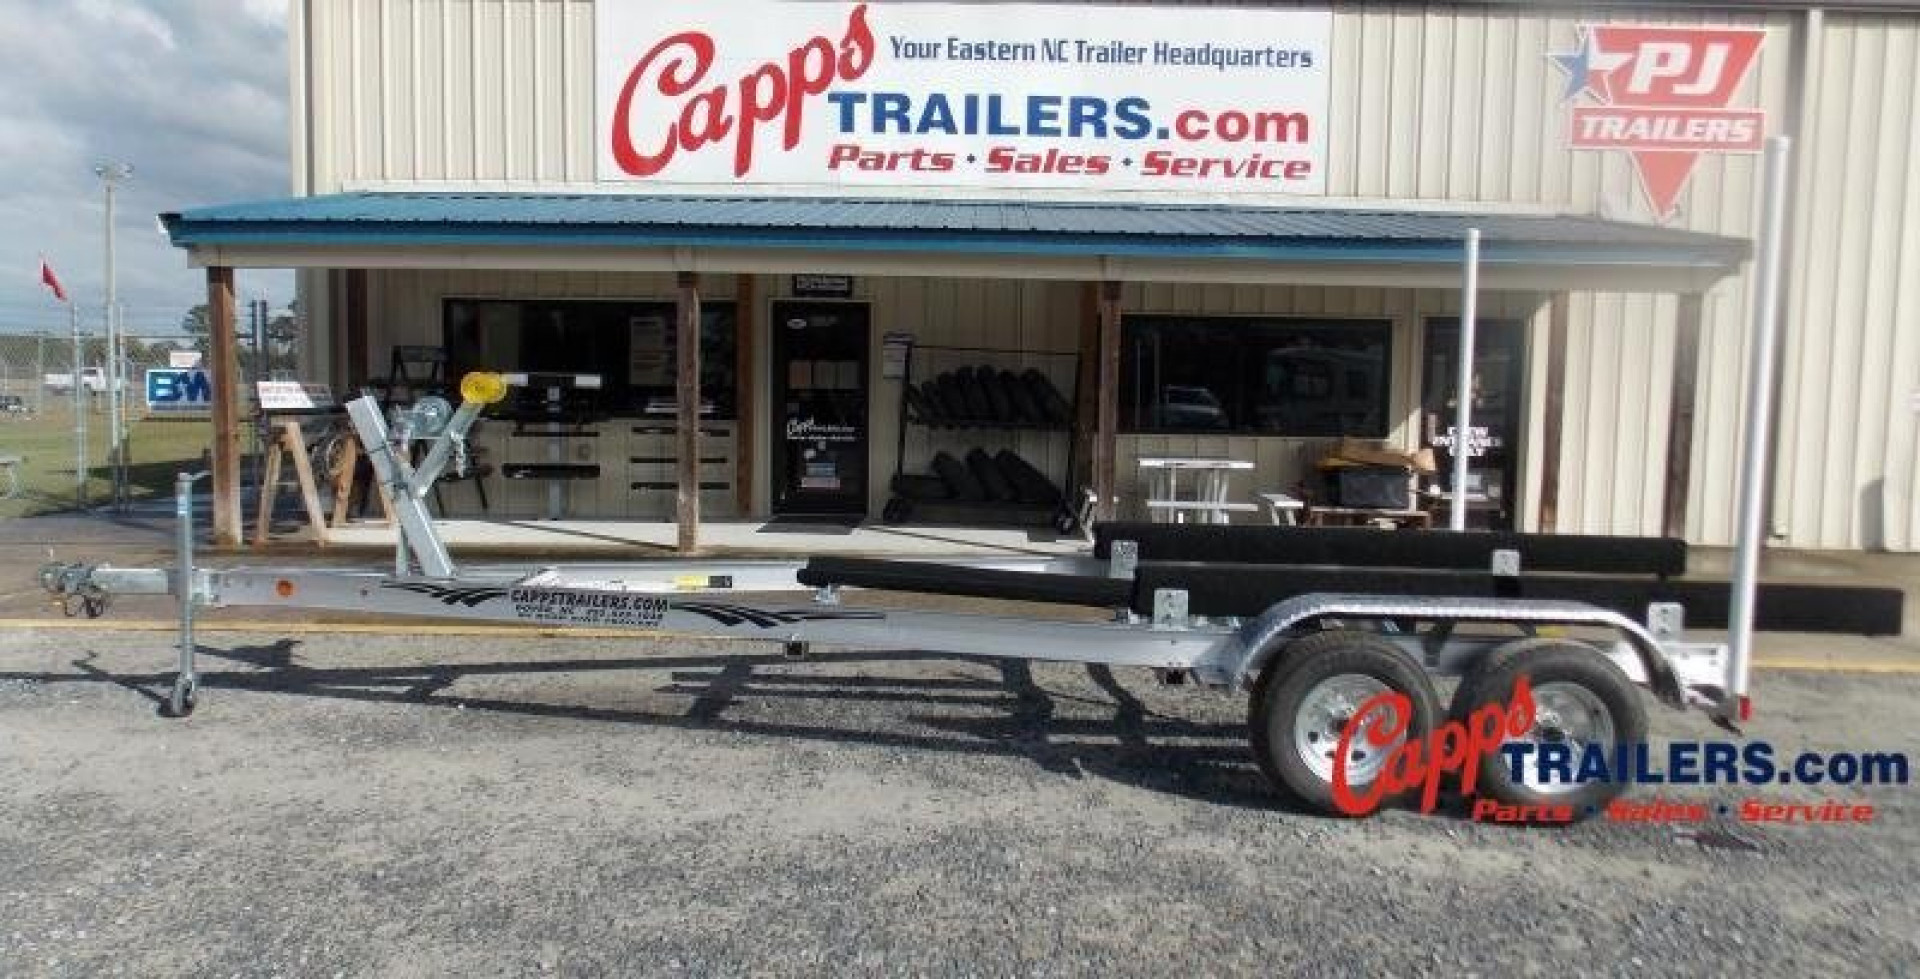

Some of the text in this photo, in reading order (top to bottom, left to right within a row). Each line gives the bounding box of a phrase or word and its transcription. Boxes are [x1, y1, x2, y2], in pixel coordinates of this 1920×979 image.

[890, 36, 1313, 71] Your Eastern NC Trailer Headquarters
[1626, 42, 1732, 95] PJ
[611, 4, 875, 178] Capps
[828, 91, 1309, 143] TRAILERS.com
[1579, 115, 1757, 142] TRAILERS
[827, 144, 1312, 180] Parts Sales Service
